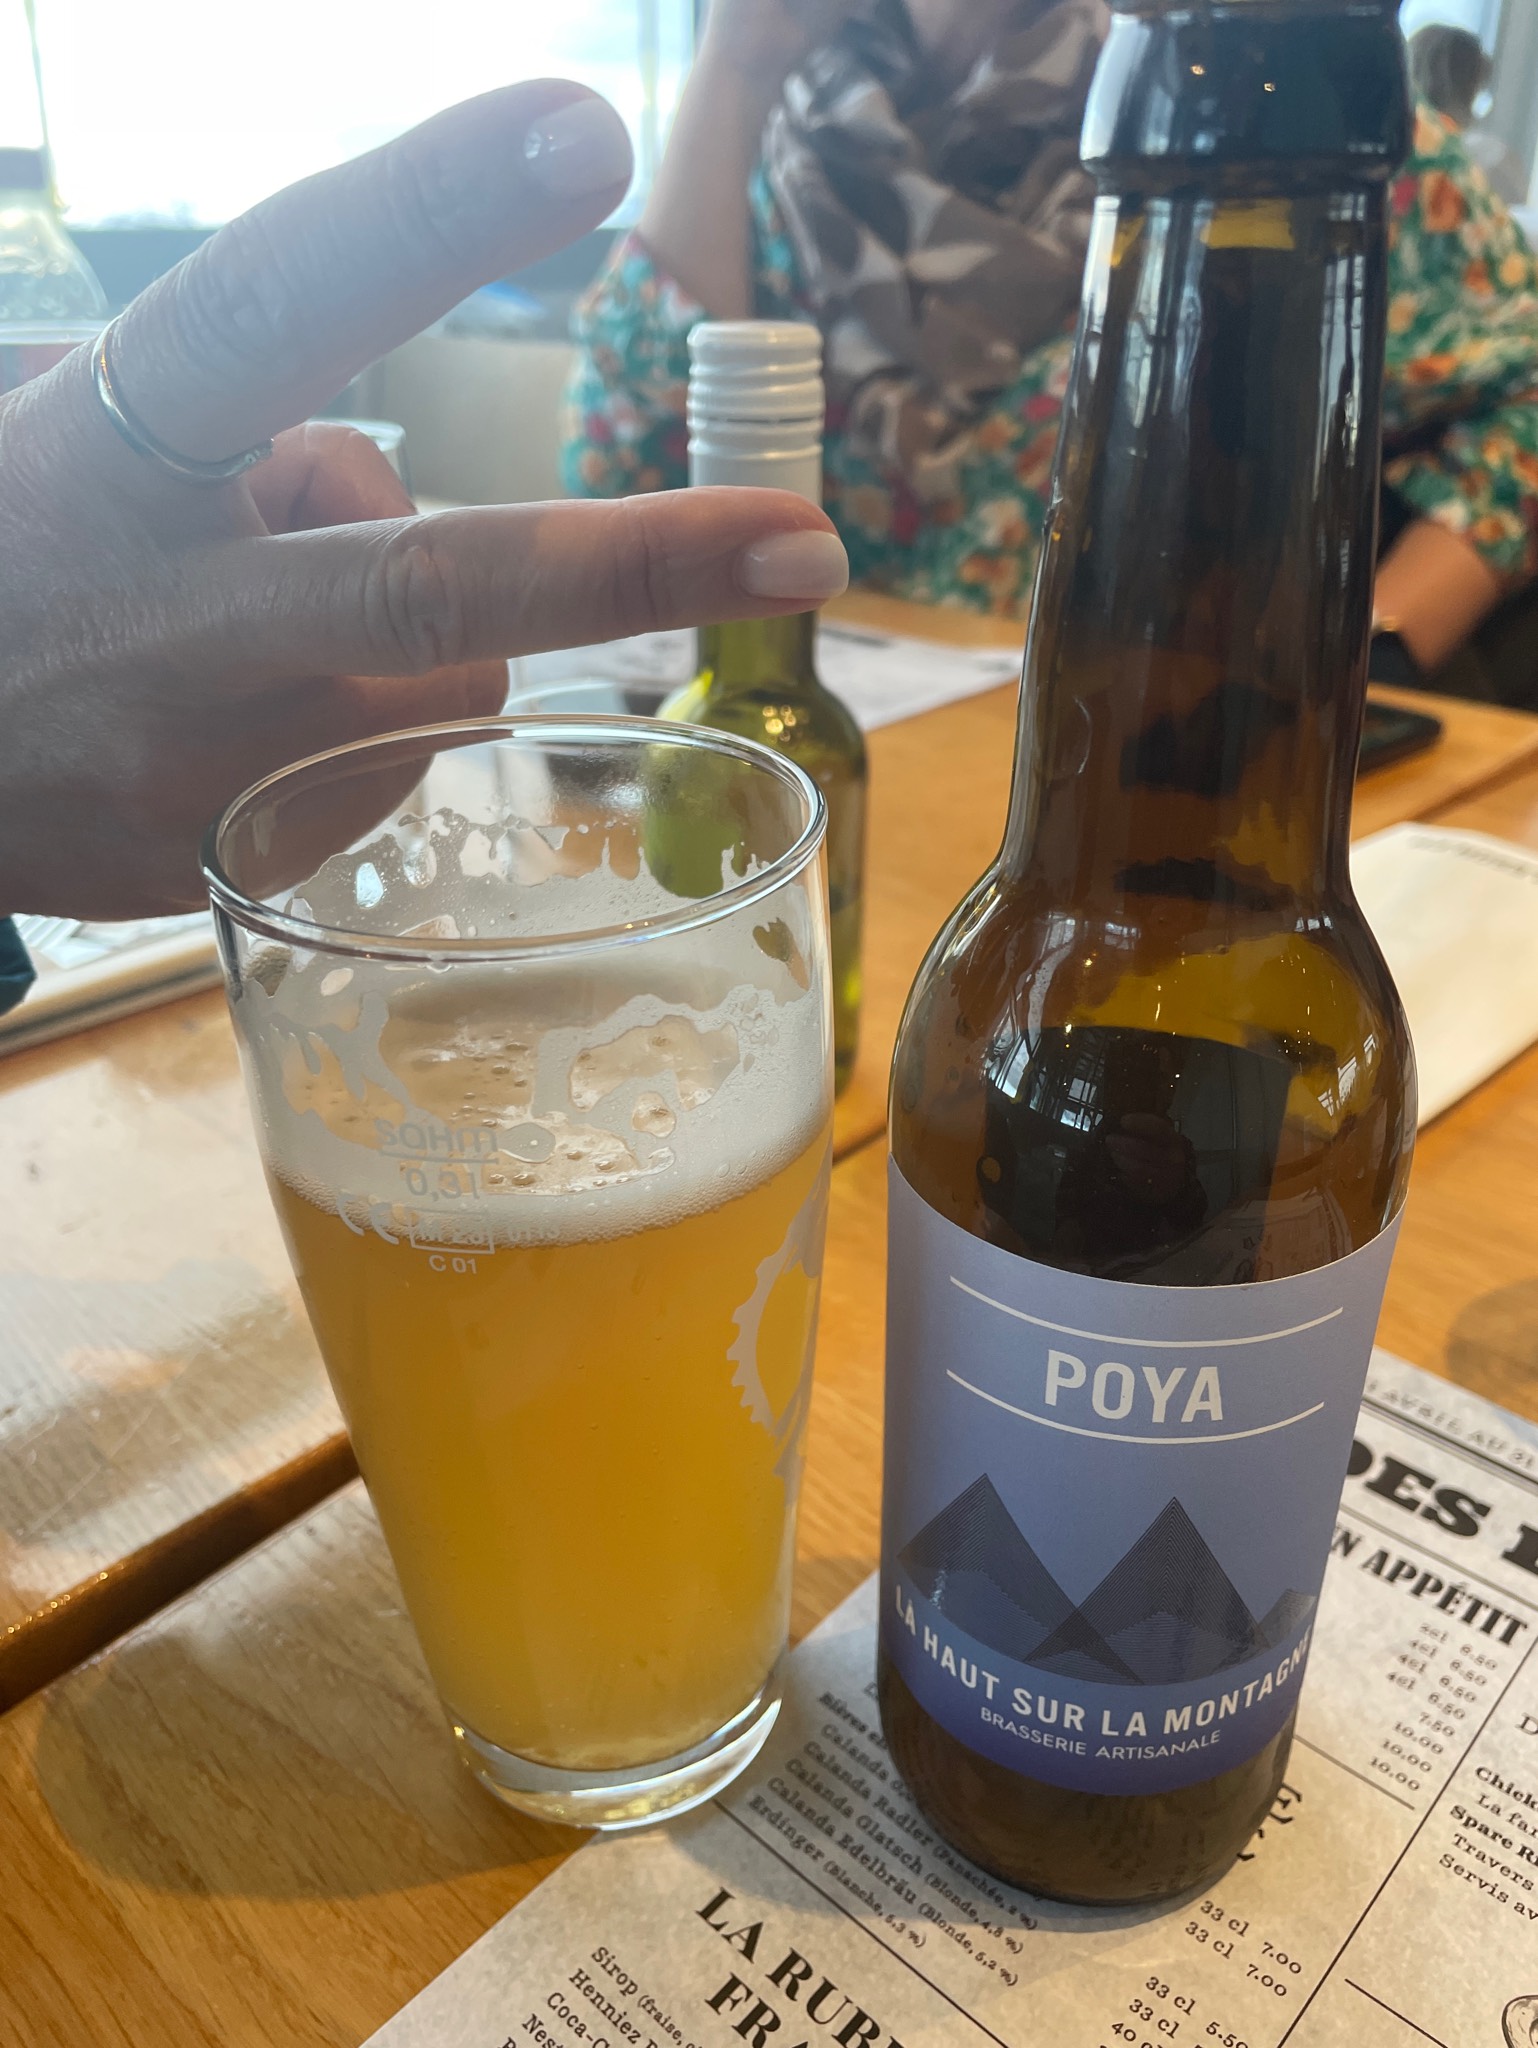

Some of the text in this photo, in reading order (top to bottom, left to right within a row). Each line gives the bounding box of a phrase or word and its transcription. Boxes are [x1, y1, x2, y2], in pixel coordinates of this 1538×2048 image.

[1045, 1349, 1224, 1424] POYA
[1360, 1547, 1529, 1647] APPÉTIT
[895, 1583, 917, 1637] LA
[924, 1625, 1000, 1701] HAUT
[1011, 1687, 1086, 1732] SUR
[1102, 1709, 1148, 1738] LA
[981, 1706, 1221, 1761] BRASSERIE ARTISANALE
[1382, 1738, 1433, 1774] 10.00
[1369, 1756, 1421, 1792] 10.00
[1476, 1793, 1502, 1817] La
[784, 1757, 855, 1819] Calanda
[855, 1814, 924, 1877] Glatsch
[872, 1795, 935, 1847] Radler
[1450, 1804, 1514, 1850] Spare
[748, 1793, 826, 1862] Erdinger
[823, 1860, 884, 1917] (Blanche,
[767, 1776, 836, 1838] Calanda
[837, 1832, 917, 1906] Edelbräu
[918, 1902, 974, 1955] (Blonde,
[1439, 1853, 1510, 1903] Servis
[1453, 1832, 1534, 1892] Travers
[694, 1885, 910, 2048] LA RUB
[1184, 1921, 1288, 1997] 33 cl 7.00
[1199, 1900, 1302, 1975] 33 cl 7.00
[567, 1967, 642, 2045] Henniez
[590, 1946, 684, 2047] Sirop (fraise,
[704, 1971, 809, 2048] FR
[1111, 2022, 1137, 2042] 40
[1129, 1998, 1180, 2039] 33 cl
[1145, 1976, 1171, 1999] 33
[1173, 1995, 1197, 2016] cl
